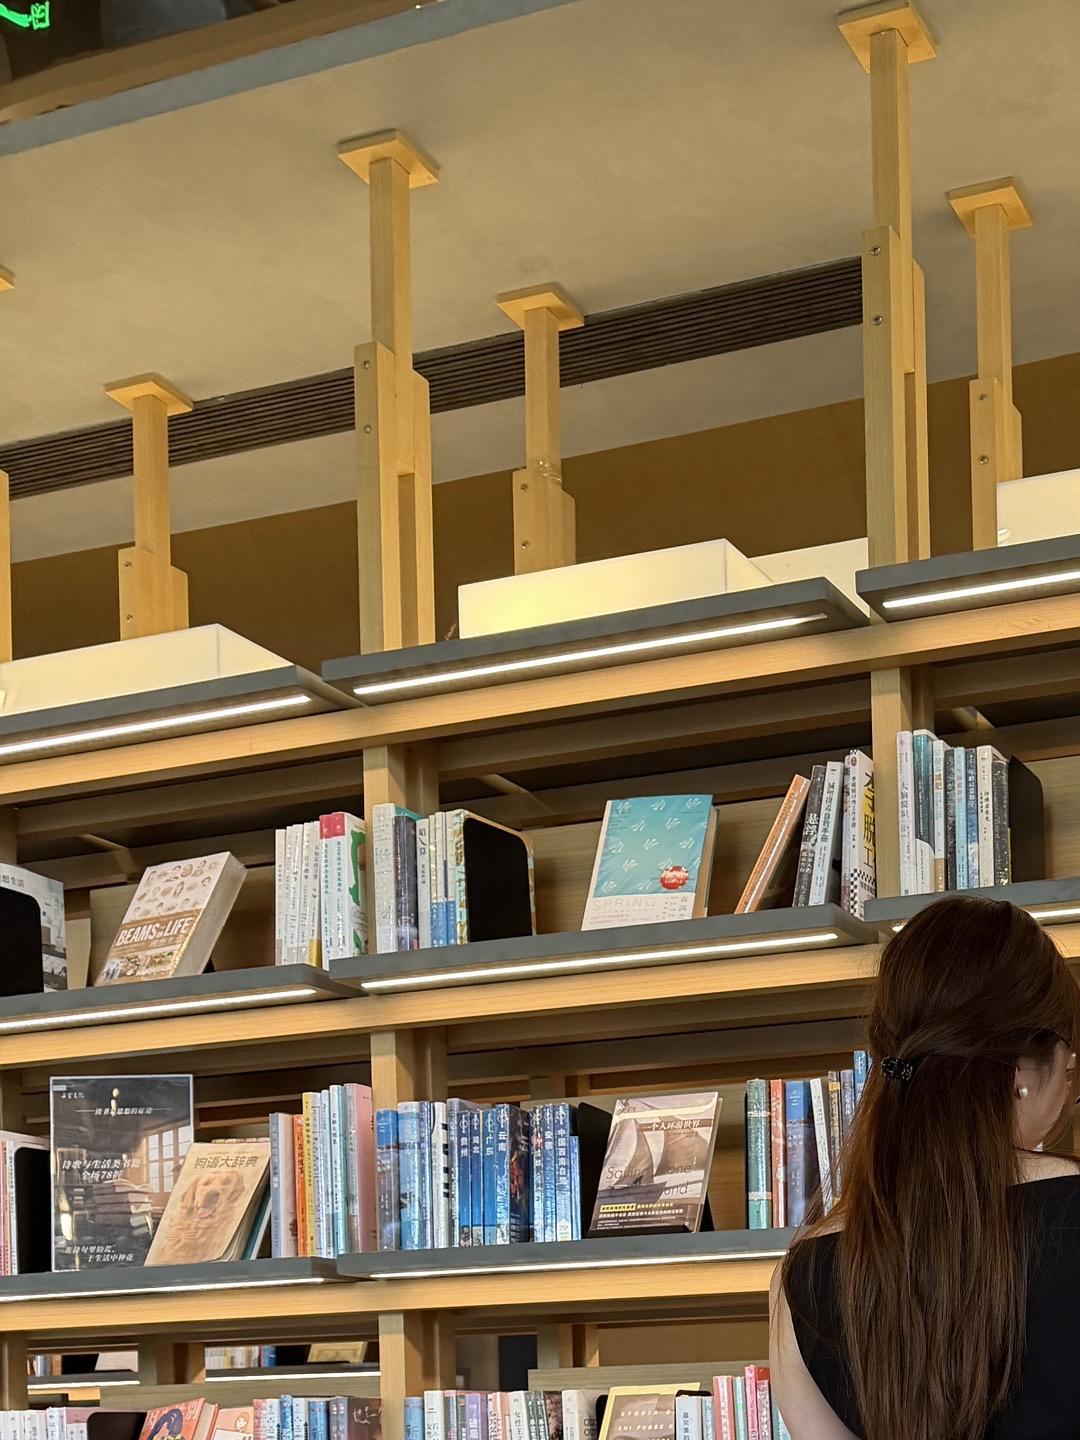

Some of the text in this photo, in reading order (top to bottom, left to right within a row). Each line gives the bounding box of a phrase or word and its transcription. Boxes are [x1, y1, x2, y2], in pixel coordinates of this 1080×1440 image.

[0, 873, 25, 888] 想生活
[115, 916, 193, 946] BEAMS LIFE
[497, 1131, 507, 1153] 云南
[193, 1155, 259, 1169] 狗语大辞典
